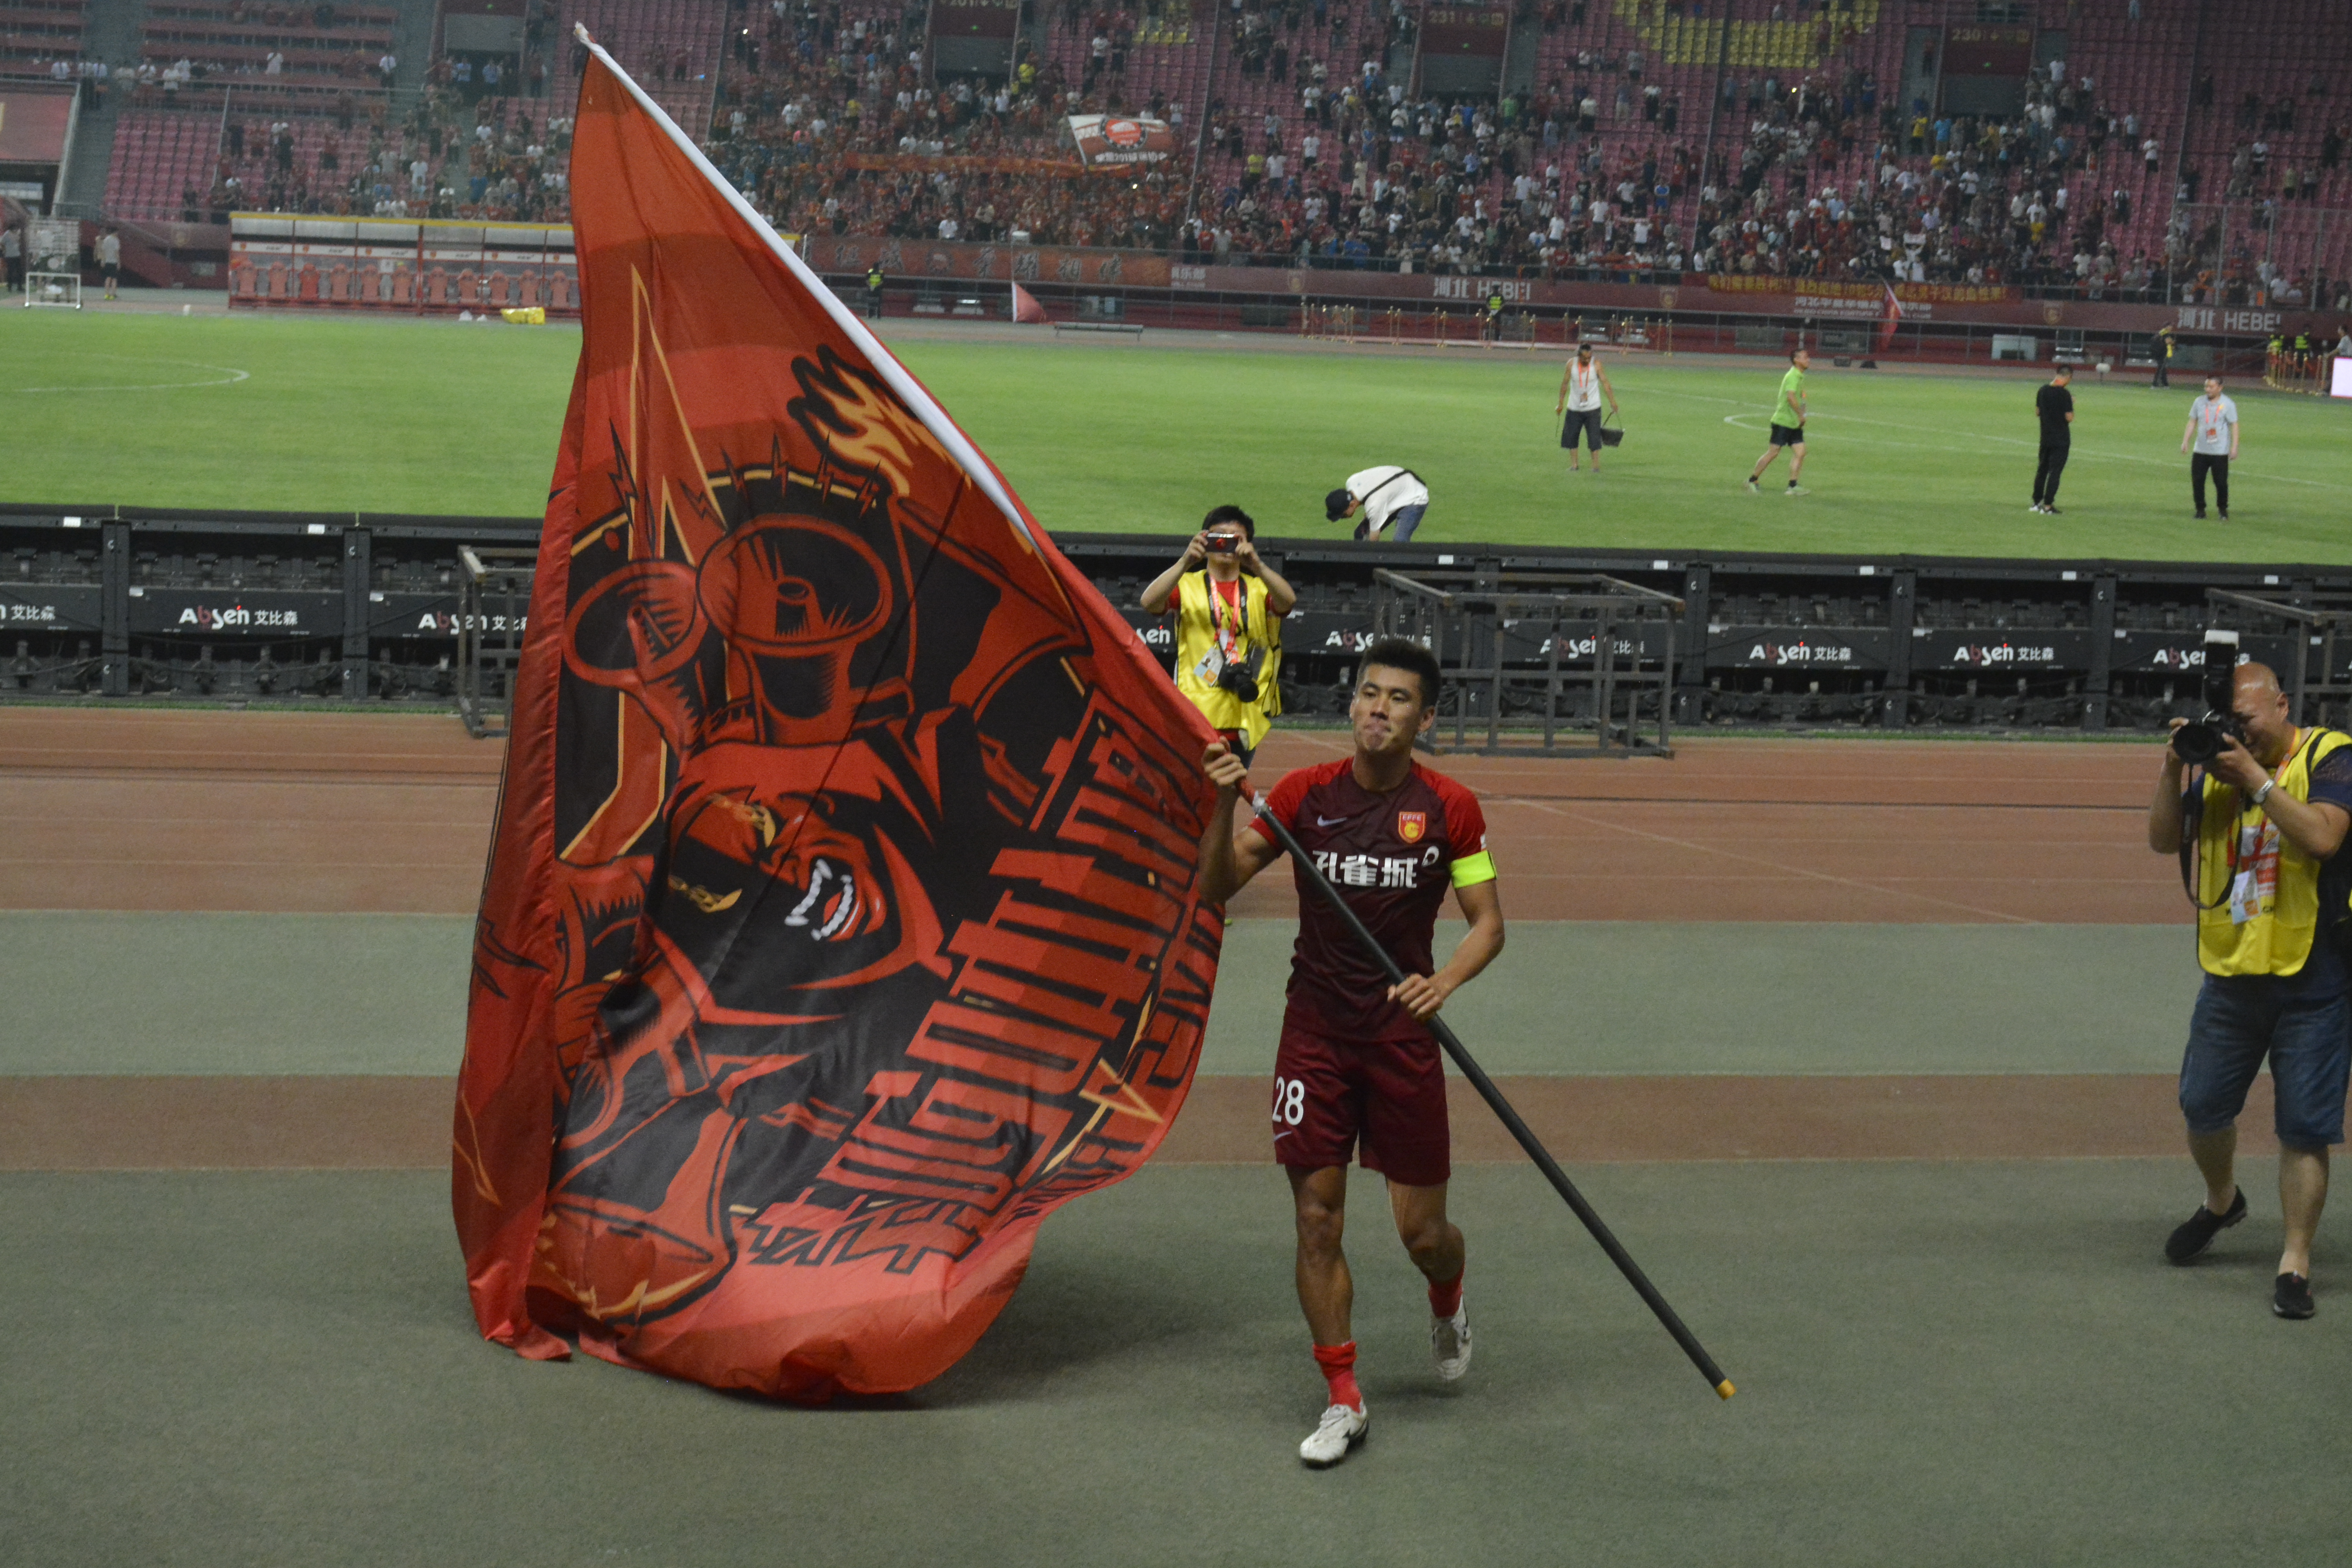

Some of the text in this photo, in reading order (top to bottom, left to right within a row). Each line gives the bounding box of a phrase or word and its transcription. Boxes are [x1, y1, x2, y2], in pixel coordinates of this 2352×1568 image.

[1433, 277, 1470, 298] 河北
[2176, 307, 2216, 330] 河北
[11, 604, 56, 621] 艾比森
[254, 610, 298, 626] 艾比森
[1813, 646, 1851, 662] 艾比森
[2017, 646, 2054, 661] 艾比森
[1312, 849, 1418, 889] 孔雀城
[1272, 1076, 1305, 1126] 28
